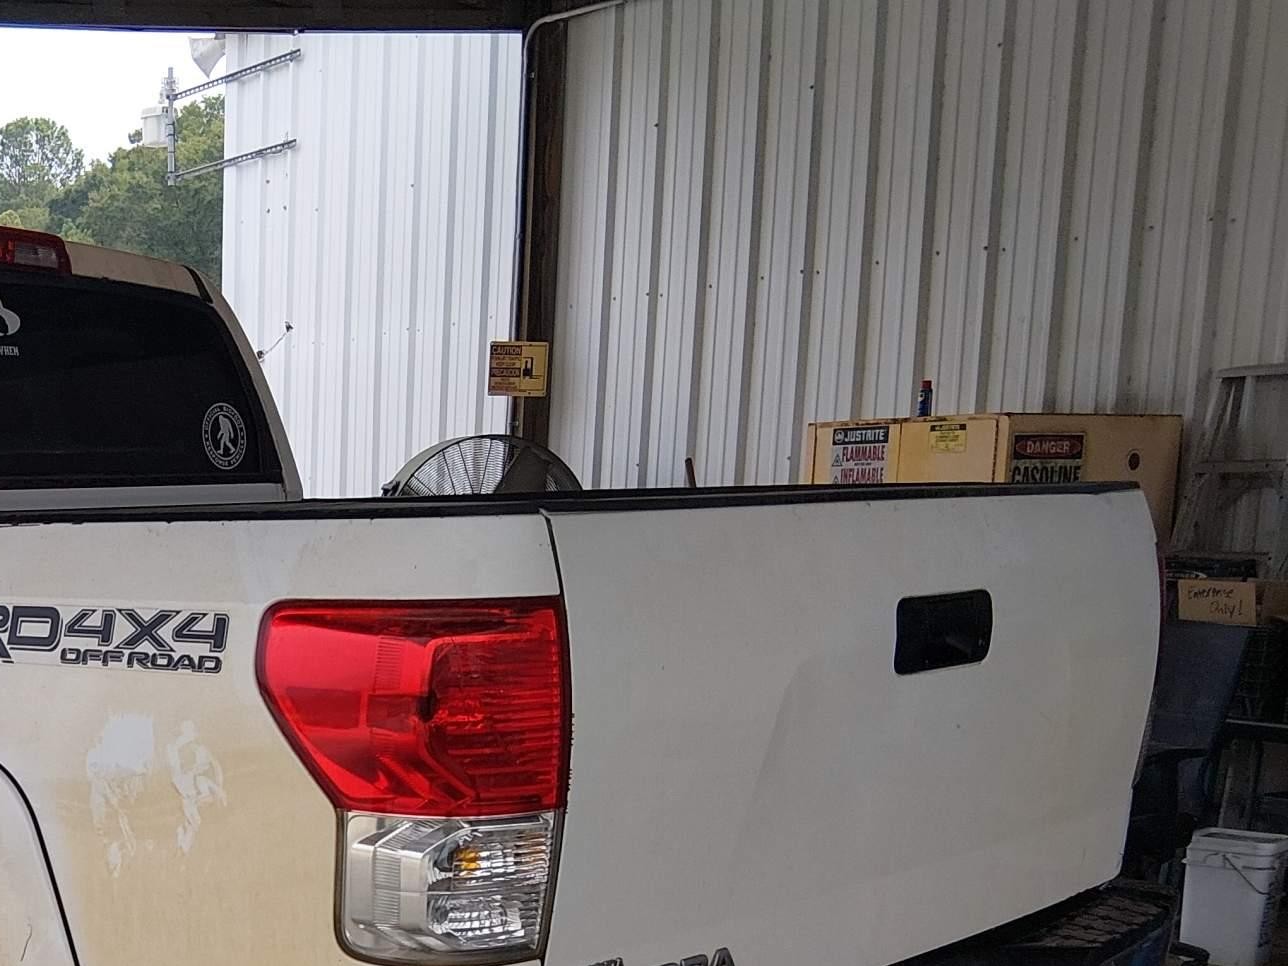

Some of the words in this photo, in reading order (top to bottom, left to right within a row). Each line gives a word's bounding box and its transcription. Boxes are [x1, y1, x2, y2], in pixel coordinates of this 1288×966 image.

[492, 346, 521, 355] CAUTION
[844, 429, 886, 442] JUSTRITE
[842, 444, 886, 463] FLAMMABLE
[1026, 440, 1071, 454] DANGER
[840, 467, 884, 484] INFLAMABLE
[1012, 465, 1081, 483] GASOLINE
[63, 607, 231, 653] 4X4
[59, 647, 125, 668] OFF
[126, 650, 223, 674] ROAD
